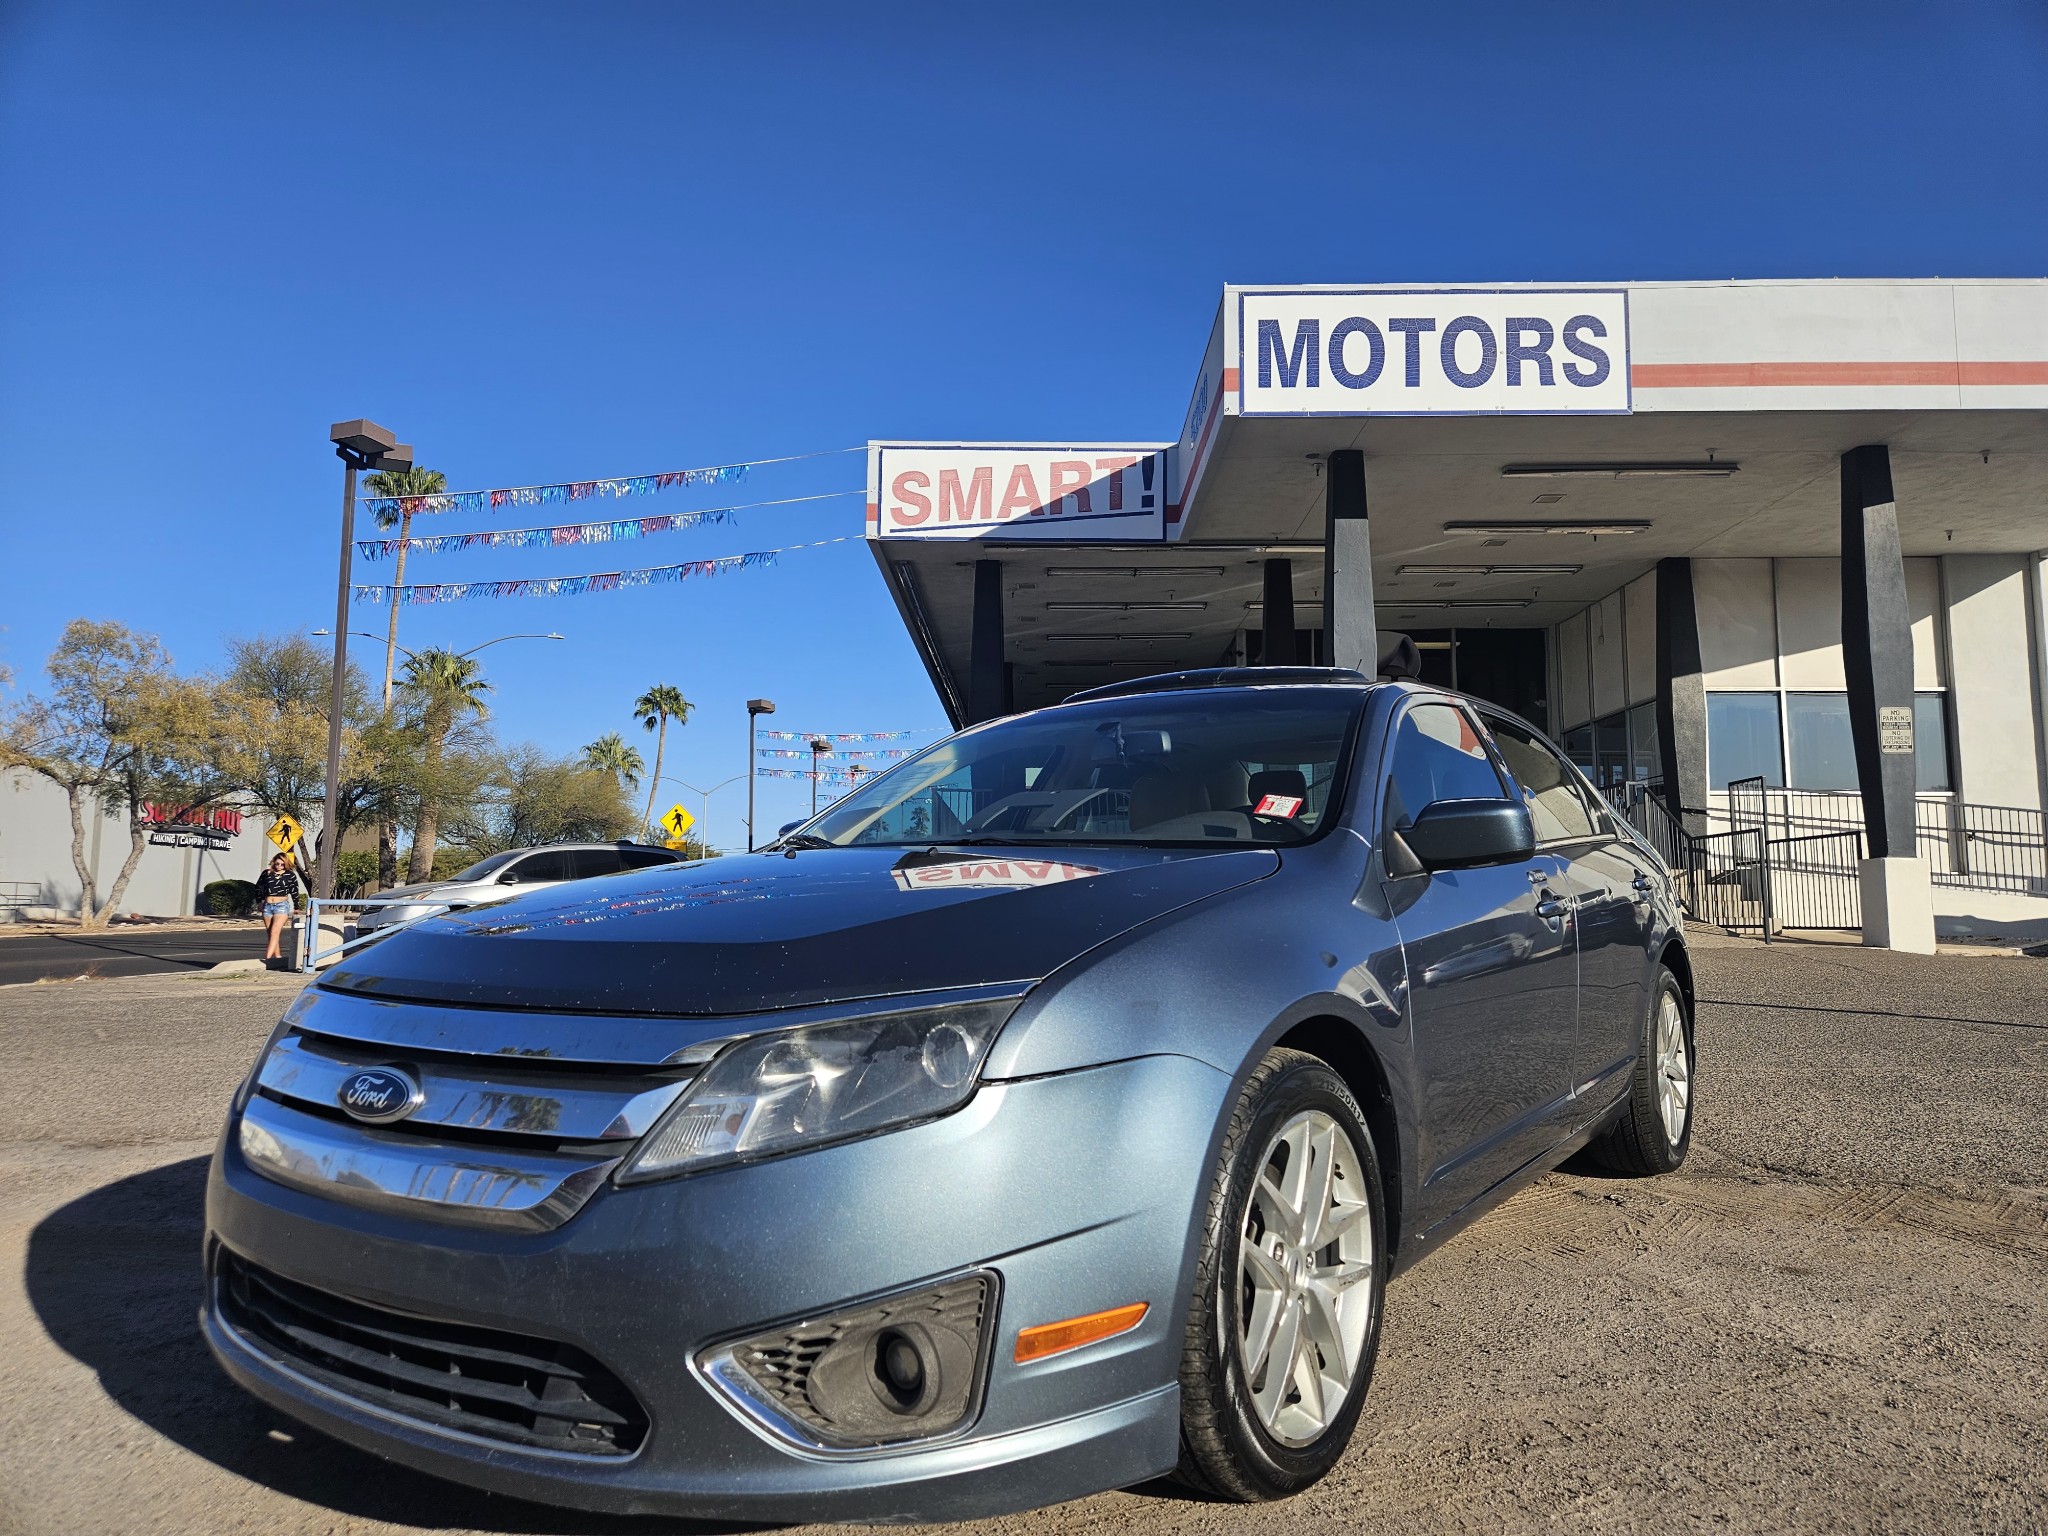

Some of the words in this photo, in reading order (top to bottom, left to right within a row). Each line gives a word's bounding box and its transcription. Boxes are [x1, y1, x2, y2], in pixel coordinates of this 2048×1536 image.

[1258, 314, 1611, 389] MOTORS
[889, 454, 1155, 526] SMART!
[153, 834, 175, 844] HIKING
[180, 836, 208, 846] CAMPING
[346, 1075, 393, 1109] Ford
